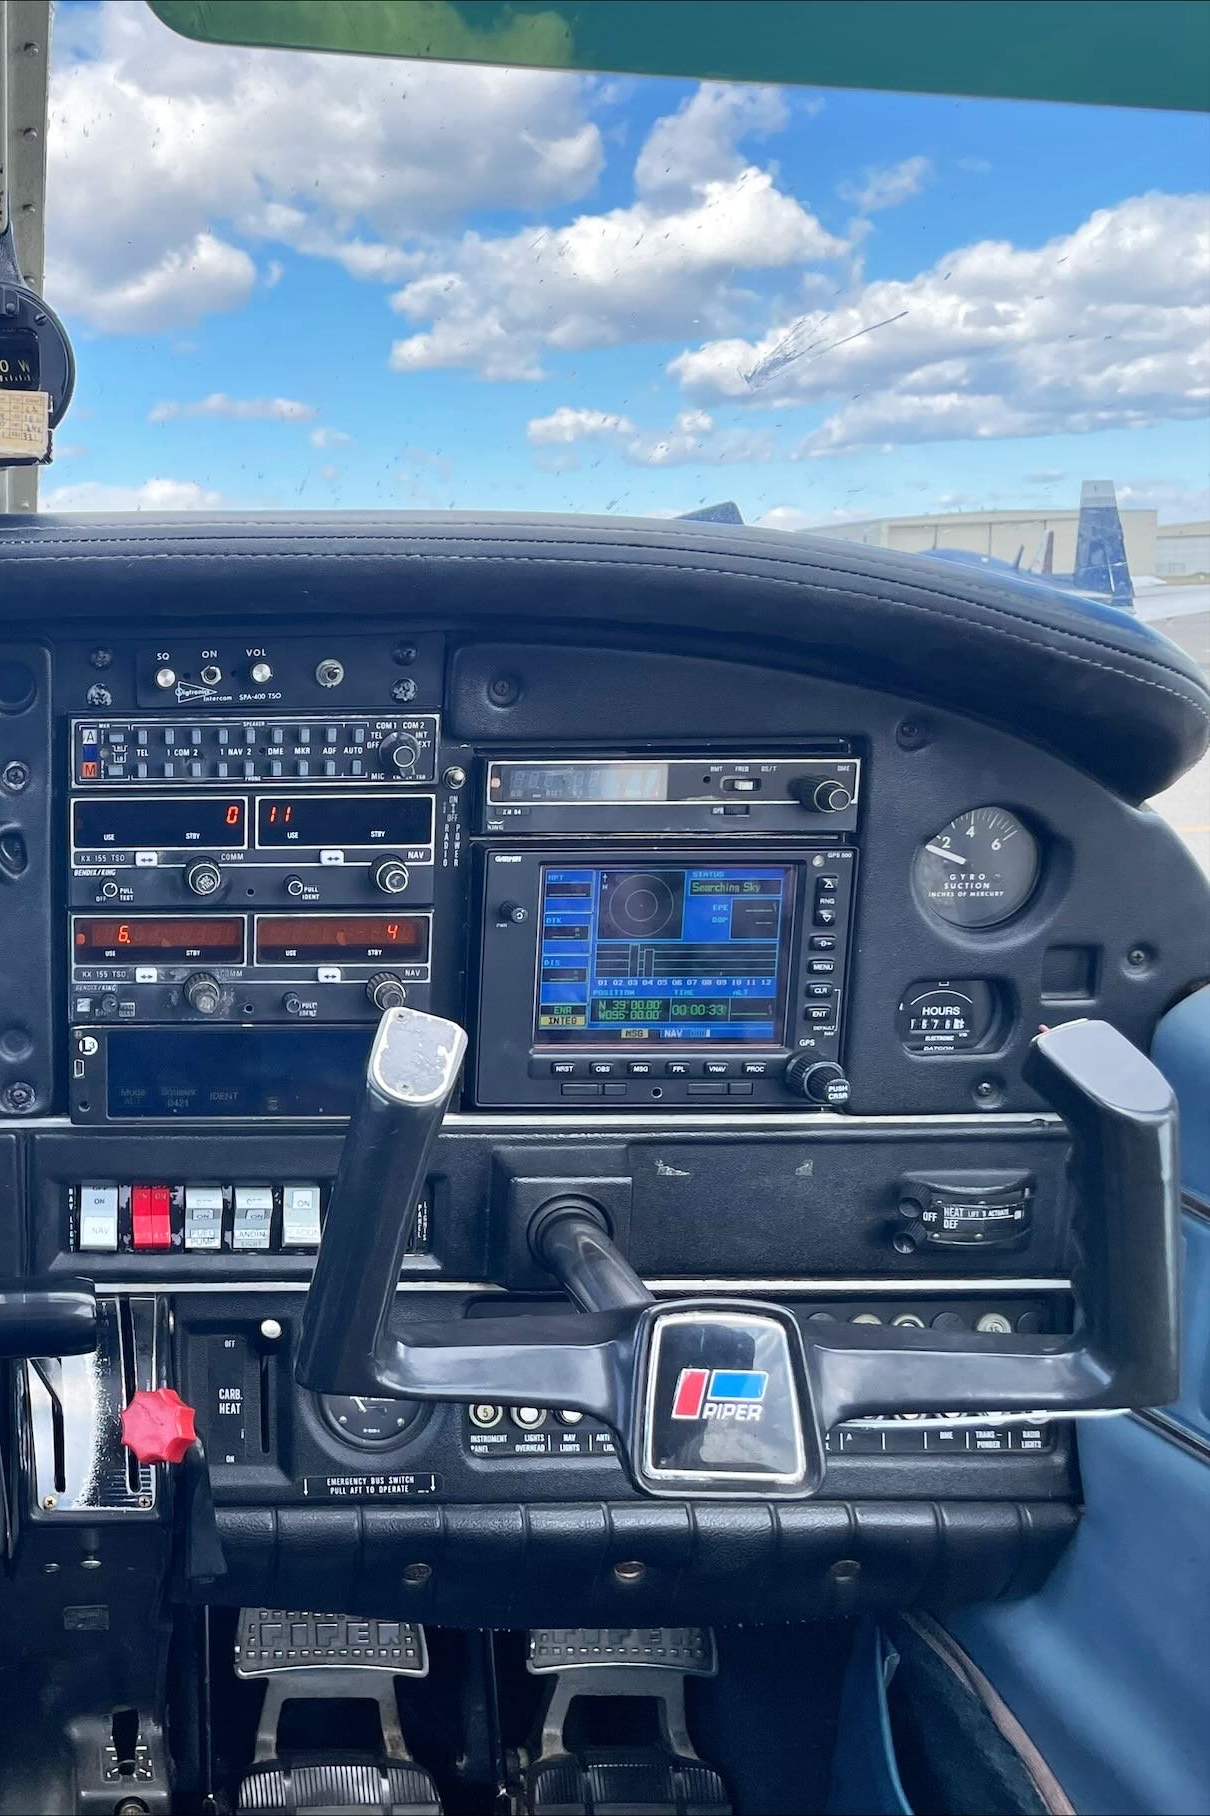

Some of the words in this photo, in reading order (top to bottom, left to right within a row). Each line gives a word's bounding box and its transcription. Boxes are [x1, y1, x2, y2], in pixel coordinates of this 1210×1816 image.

[202, 650, 217, 658] ON
[376, 722, 391, 730] COM
[403, 721, 418, 729] COM
[228, 748, 242, 756] NAV
[294, 747, 310, 755] MKR
[323, 747, 336, 755] ADF
[371, 830, 386, 838] STBY
[966, 826, 975, 838] 4
[942, 837, 951, 848] 2
[992, 839, 1001, 850] 6
[111, 854, 124, 862] TSO
[408, 851, 424, 859] NAV
[743, 883, 761, 894] Sky
[387, 925, 399, 940] 4
[405, 969, 420, 977] NAV
[554, 1007, 572, 1015] ENR
[922, 1006, 960, 1015] HOURS
[548, 1017, 577, 1025] INTEG
[664, 1029, 682, 1038] NAV
[828, 1092, 848, 1100] CRSR
[922, 1211, 938, 1222] OFF
[944, 1208, 964, 1217] HEAT
[944, 1220, 958, 1229] DEF
[225, 1340, 235, 1348] OFF
[219, 1389, 243, 1400] CARB.
[219, 1403, 241, 1415] HEAT
[702, 1403, 763, 1421] PIPER
[226, 1455, 235, 1463] ON
[327, 1478, 367, 1486] EMERGENCY
[389, 1476, 414, 1484] SWITCH
[379, 1485, 409, 1493] OPERATE
